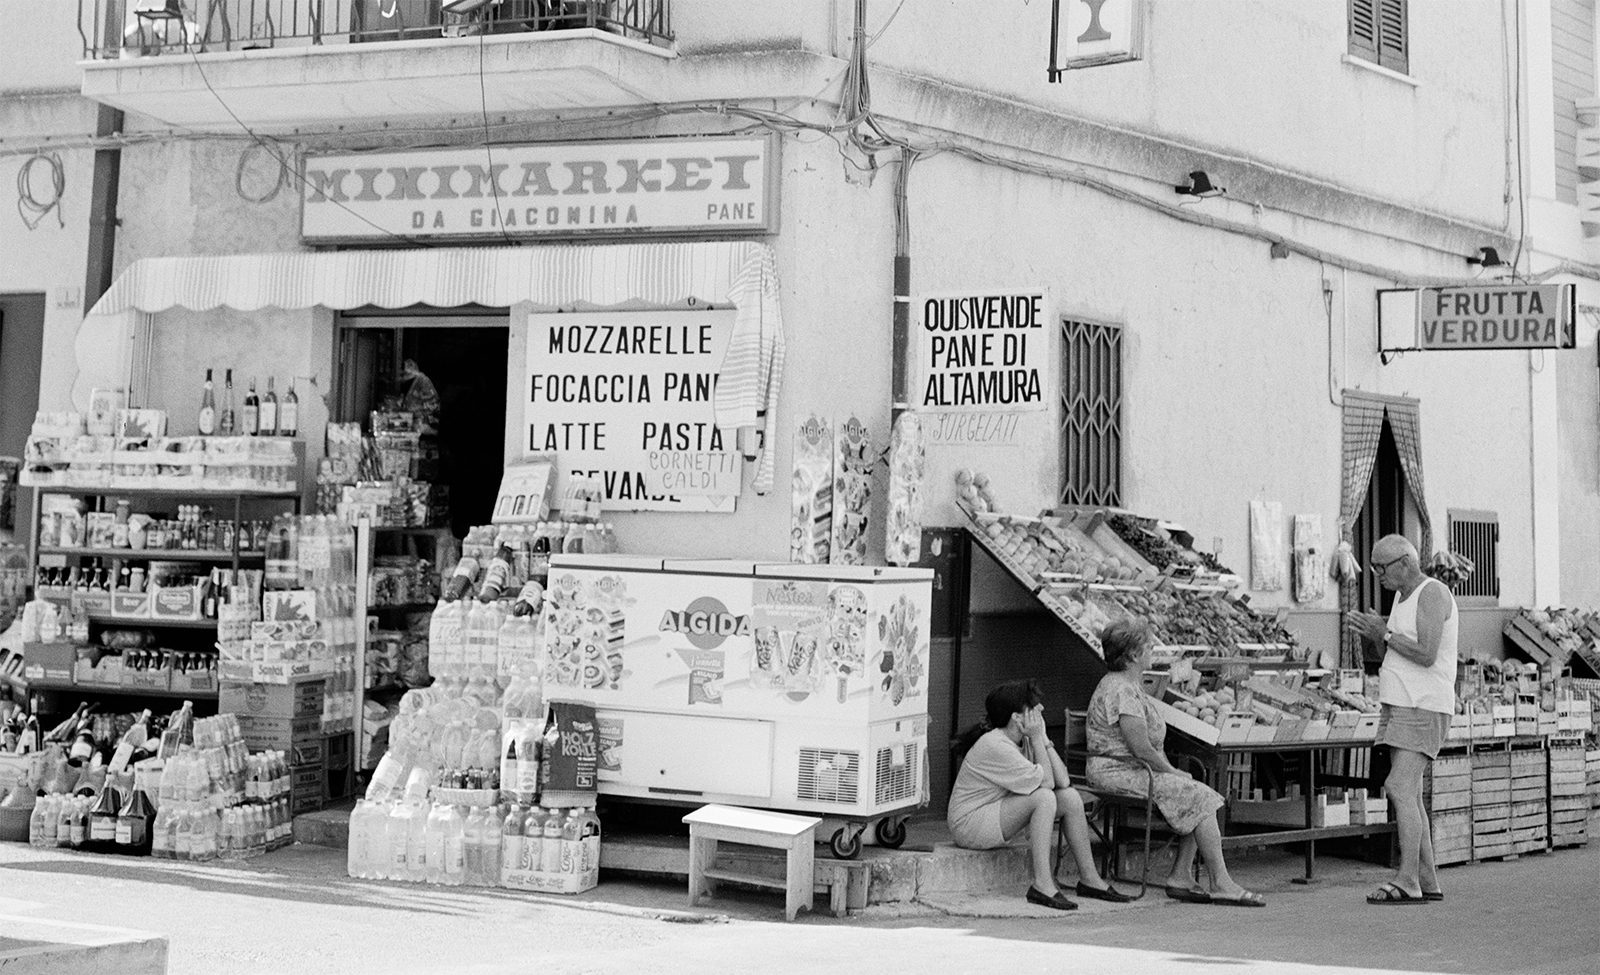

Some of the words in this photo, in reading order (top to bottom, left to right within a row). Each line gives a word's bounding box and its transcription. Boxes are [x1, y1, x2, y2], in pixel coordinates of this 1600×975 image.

[307, 154, 760, 202] MINIMARKET
[412, 210, 445, 229] DA
[470, 204, 639, 227] GIACOMINA
[707, 202, 755, 220] PANE
[1436, 291, 1544, 316] FRUTTA
[549, 325, 712, 355] MOZZARELLE
[1423, 318, 1556, 343] VERDURA
[931, 333, 994, 368] PANE
[1003, 333, 1026, 366] DI
[531, 373, 651, 403] FOCACCIA
[664, 373, 719, 402] PAN
[923, 368, 1042, 406] ALTAMURA
[529, 422, 606, 451] LATTE
[642, 422, 724, 451] PASTA
[649, 451, 735, 473] CORNETTI
[662, 471, 717, 490] CALDI
[659, 609, 751, 637] ALGIDA
[561, 730, 595, 747] HOLZ
[562, 741, 597, 757] KOHLE
